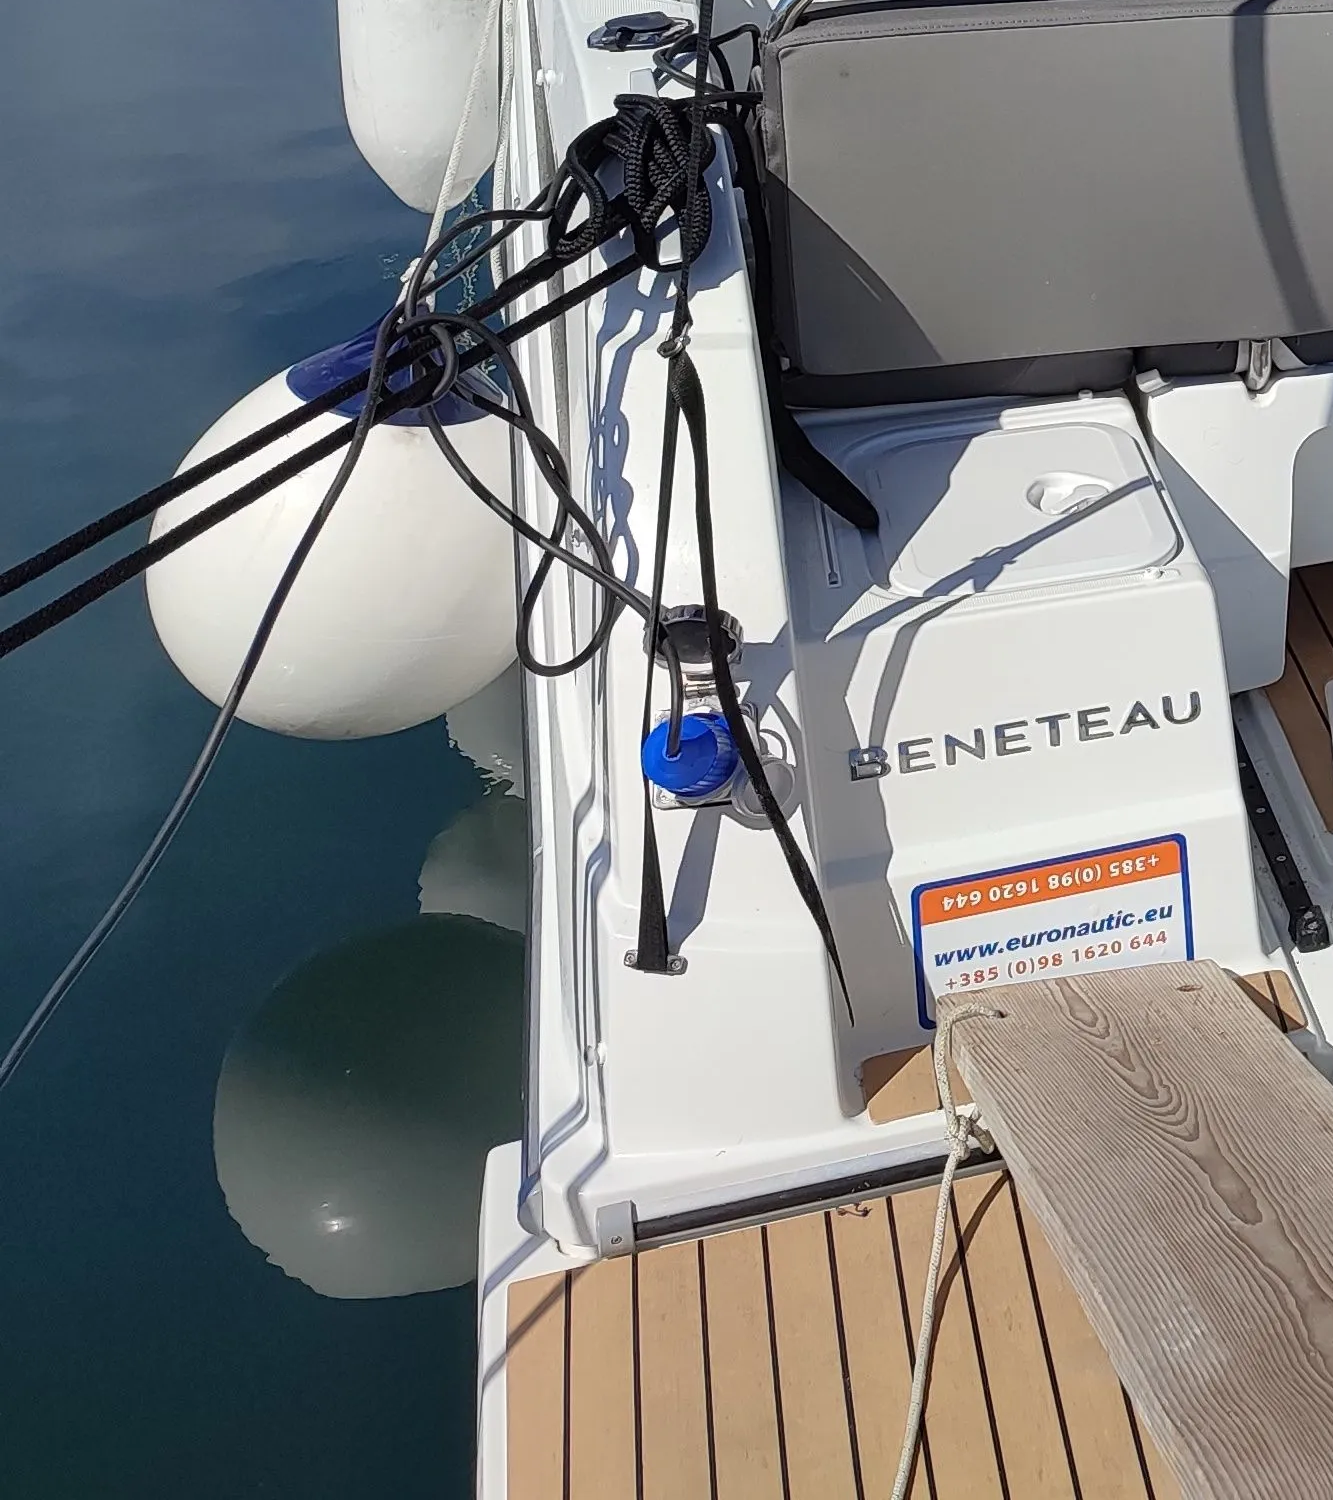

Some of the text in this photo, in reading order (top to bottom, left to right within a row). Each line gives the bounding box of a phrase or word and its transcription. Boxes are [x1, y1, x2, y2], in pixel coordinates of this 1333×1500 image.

[848, 690, 1203, 782] BENETEAU
[941, 853, 1160, 912] +385 (0)98 1620 644
[933, 904, 1173, 968] www.euronautic.eu
[944, 930, 1168, 991] +385 (0)98 1620 644
